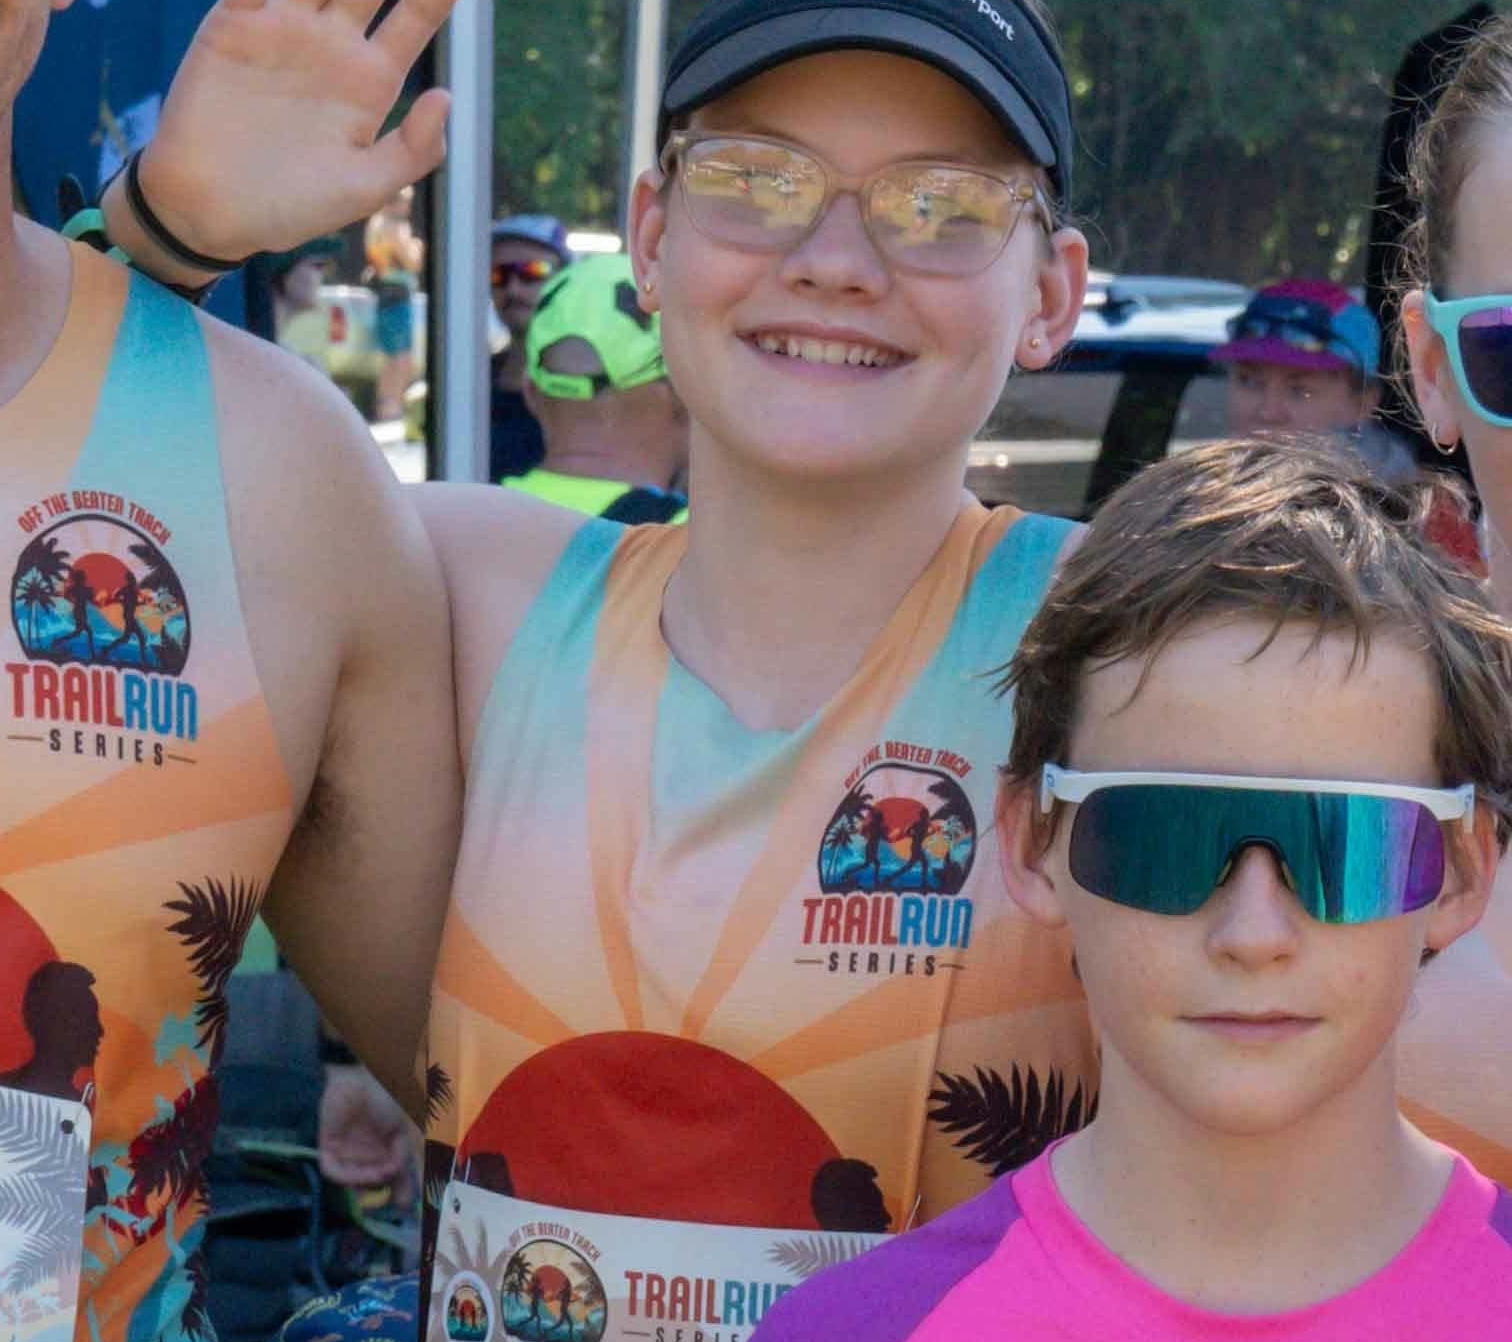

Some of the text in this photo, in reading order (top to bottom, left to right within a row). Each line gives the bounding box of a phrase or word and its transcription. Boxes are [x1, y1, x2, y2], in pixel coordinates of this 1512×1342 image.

[42, 493, 72, 516] THE
[72, 490, 124, 515] BEATEN
[4, 662, 198, 742] TRAILRUN
[49, 728, 165, 766] SERIES
[802, 895, 974, 949] TRAILRUN
[828, 951, 937, 977] SERIES
